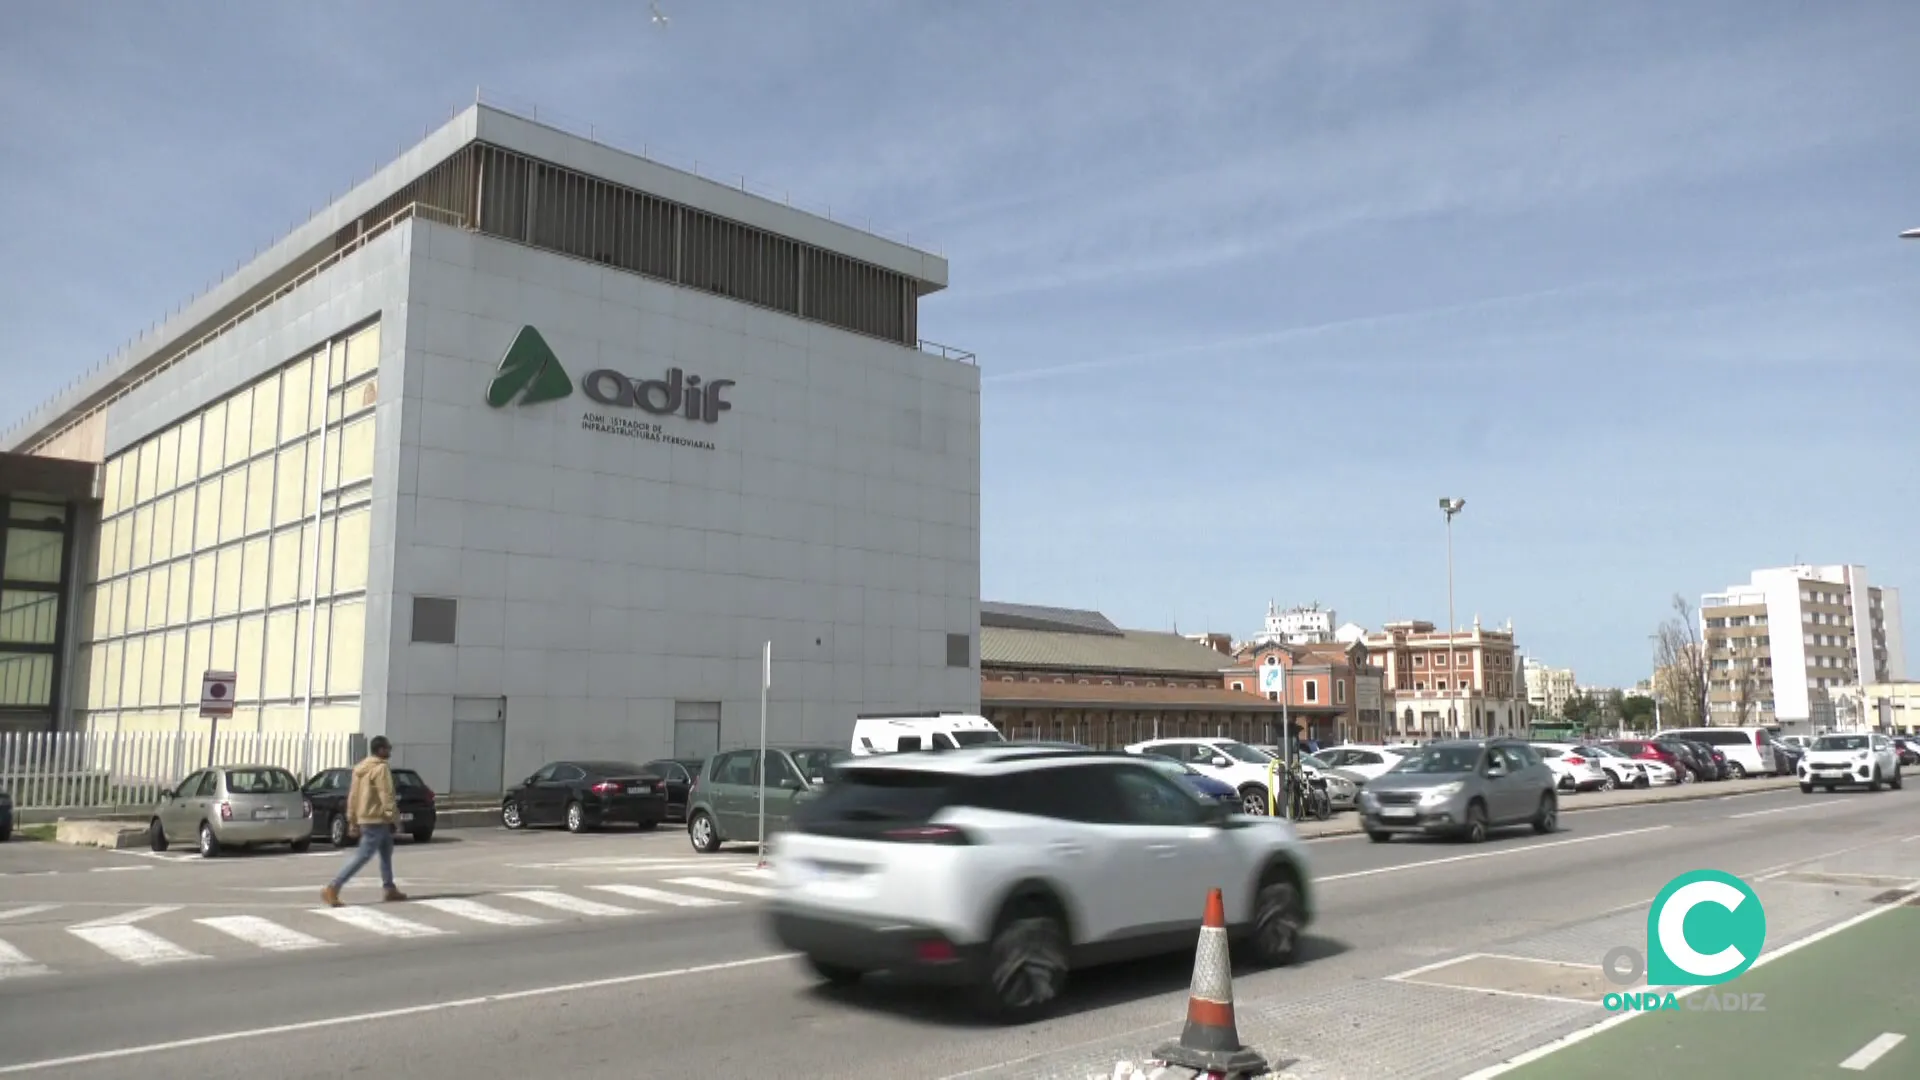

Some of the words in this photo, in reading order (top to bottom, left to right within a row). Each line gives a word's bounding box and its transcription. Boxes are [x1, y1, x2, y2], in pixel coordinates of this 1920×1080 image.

[583, 367, 736, 423] adif
[582, 421, 661, 441] INFRAESTRUCTURAS
[662, 435, 716, 450] FERROVIARIAS
[583, 412, 650, 432] ADMIISTRADOR
[652, 424, 663, 434] DE
